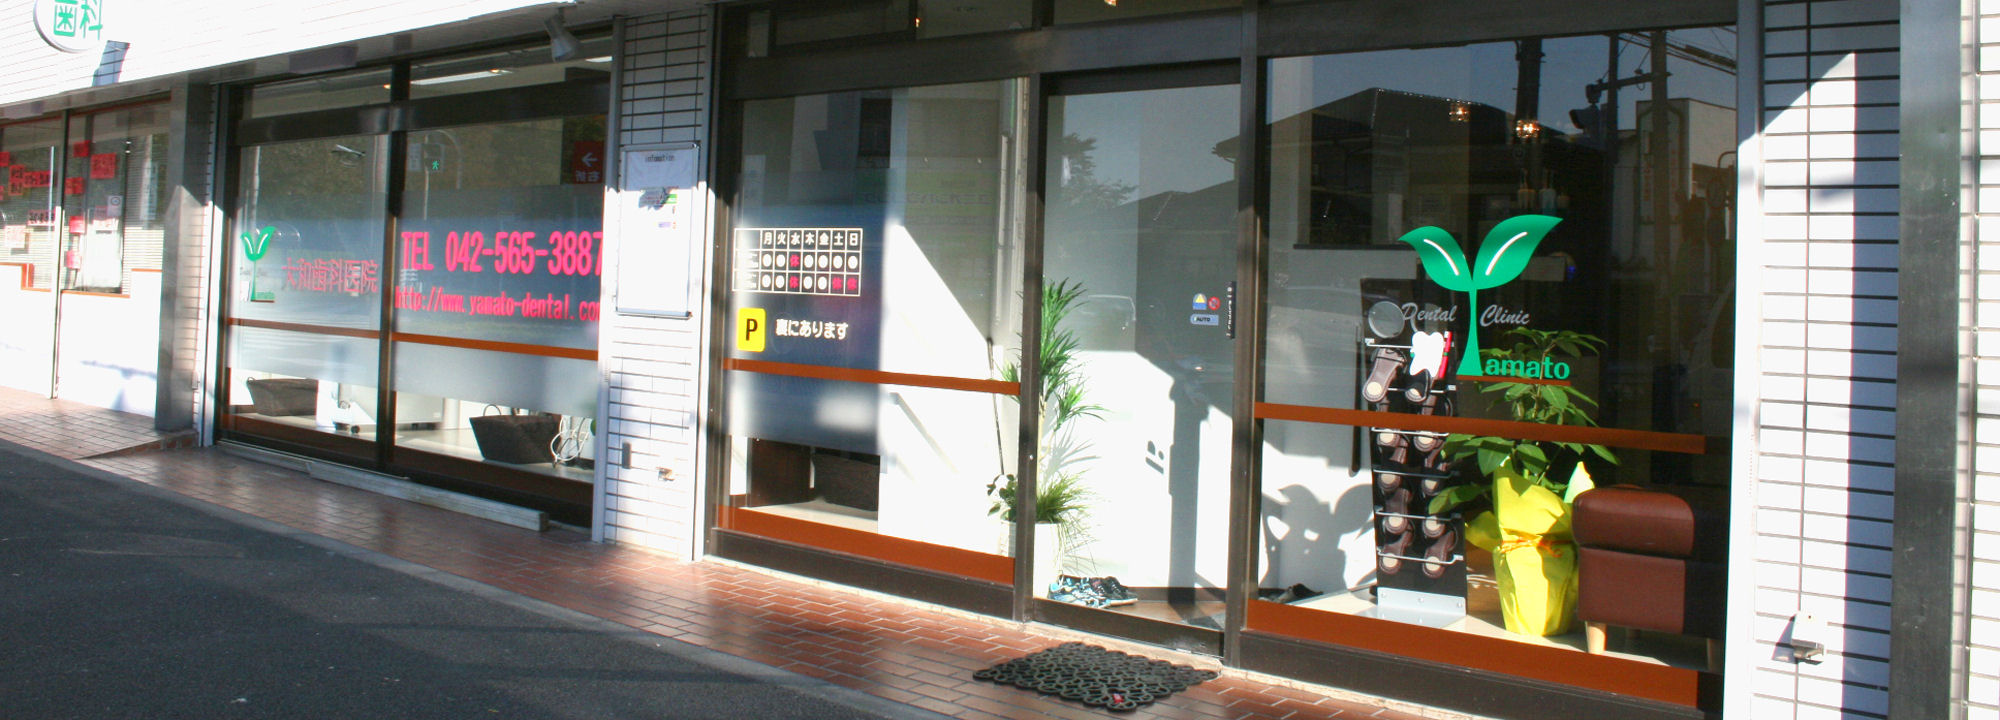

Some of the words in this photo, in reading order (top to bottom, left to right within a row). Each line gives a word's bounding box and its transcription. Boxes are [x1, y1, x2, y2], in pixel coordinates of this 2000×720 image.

[54, 0, 103, 40] 歯科
[401, 231, 434, 271] TEL
[445, 230, 603, 277] 042-565-3887
[281, 257, 379, 294] 大和歯科医院
[745, 318, 758, 341] P
[775, 318, 849, 340] 裏にあります
[1401, 302, 1458, 323] Dental
[1480, 303, 1531, 327] Clinic
